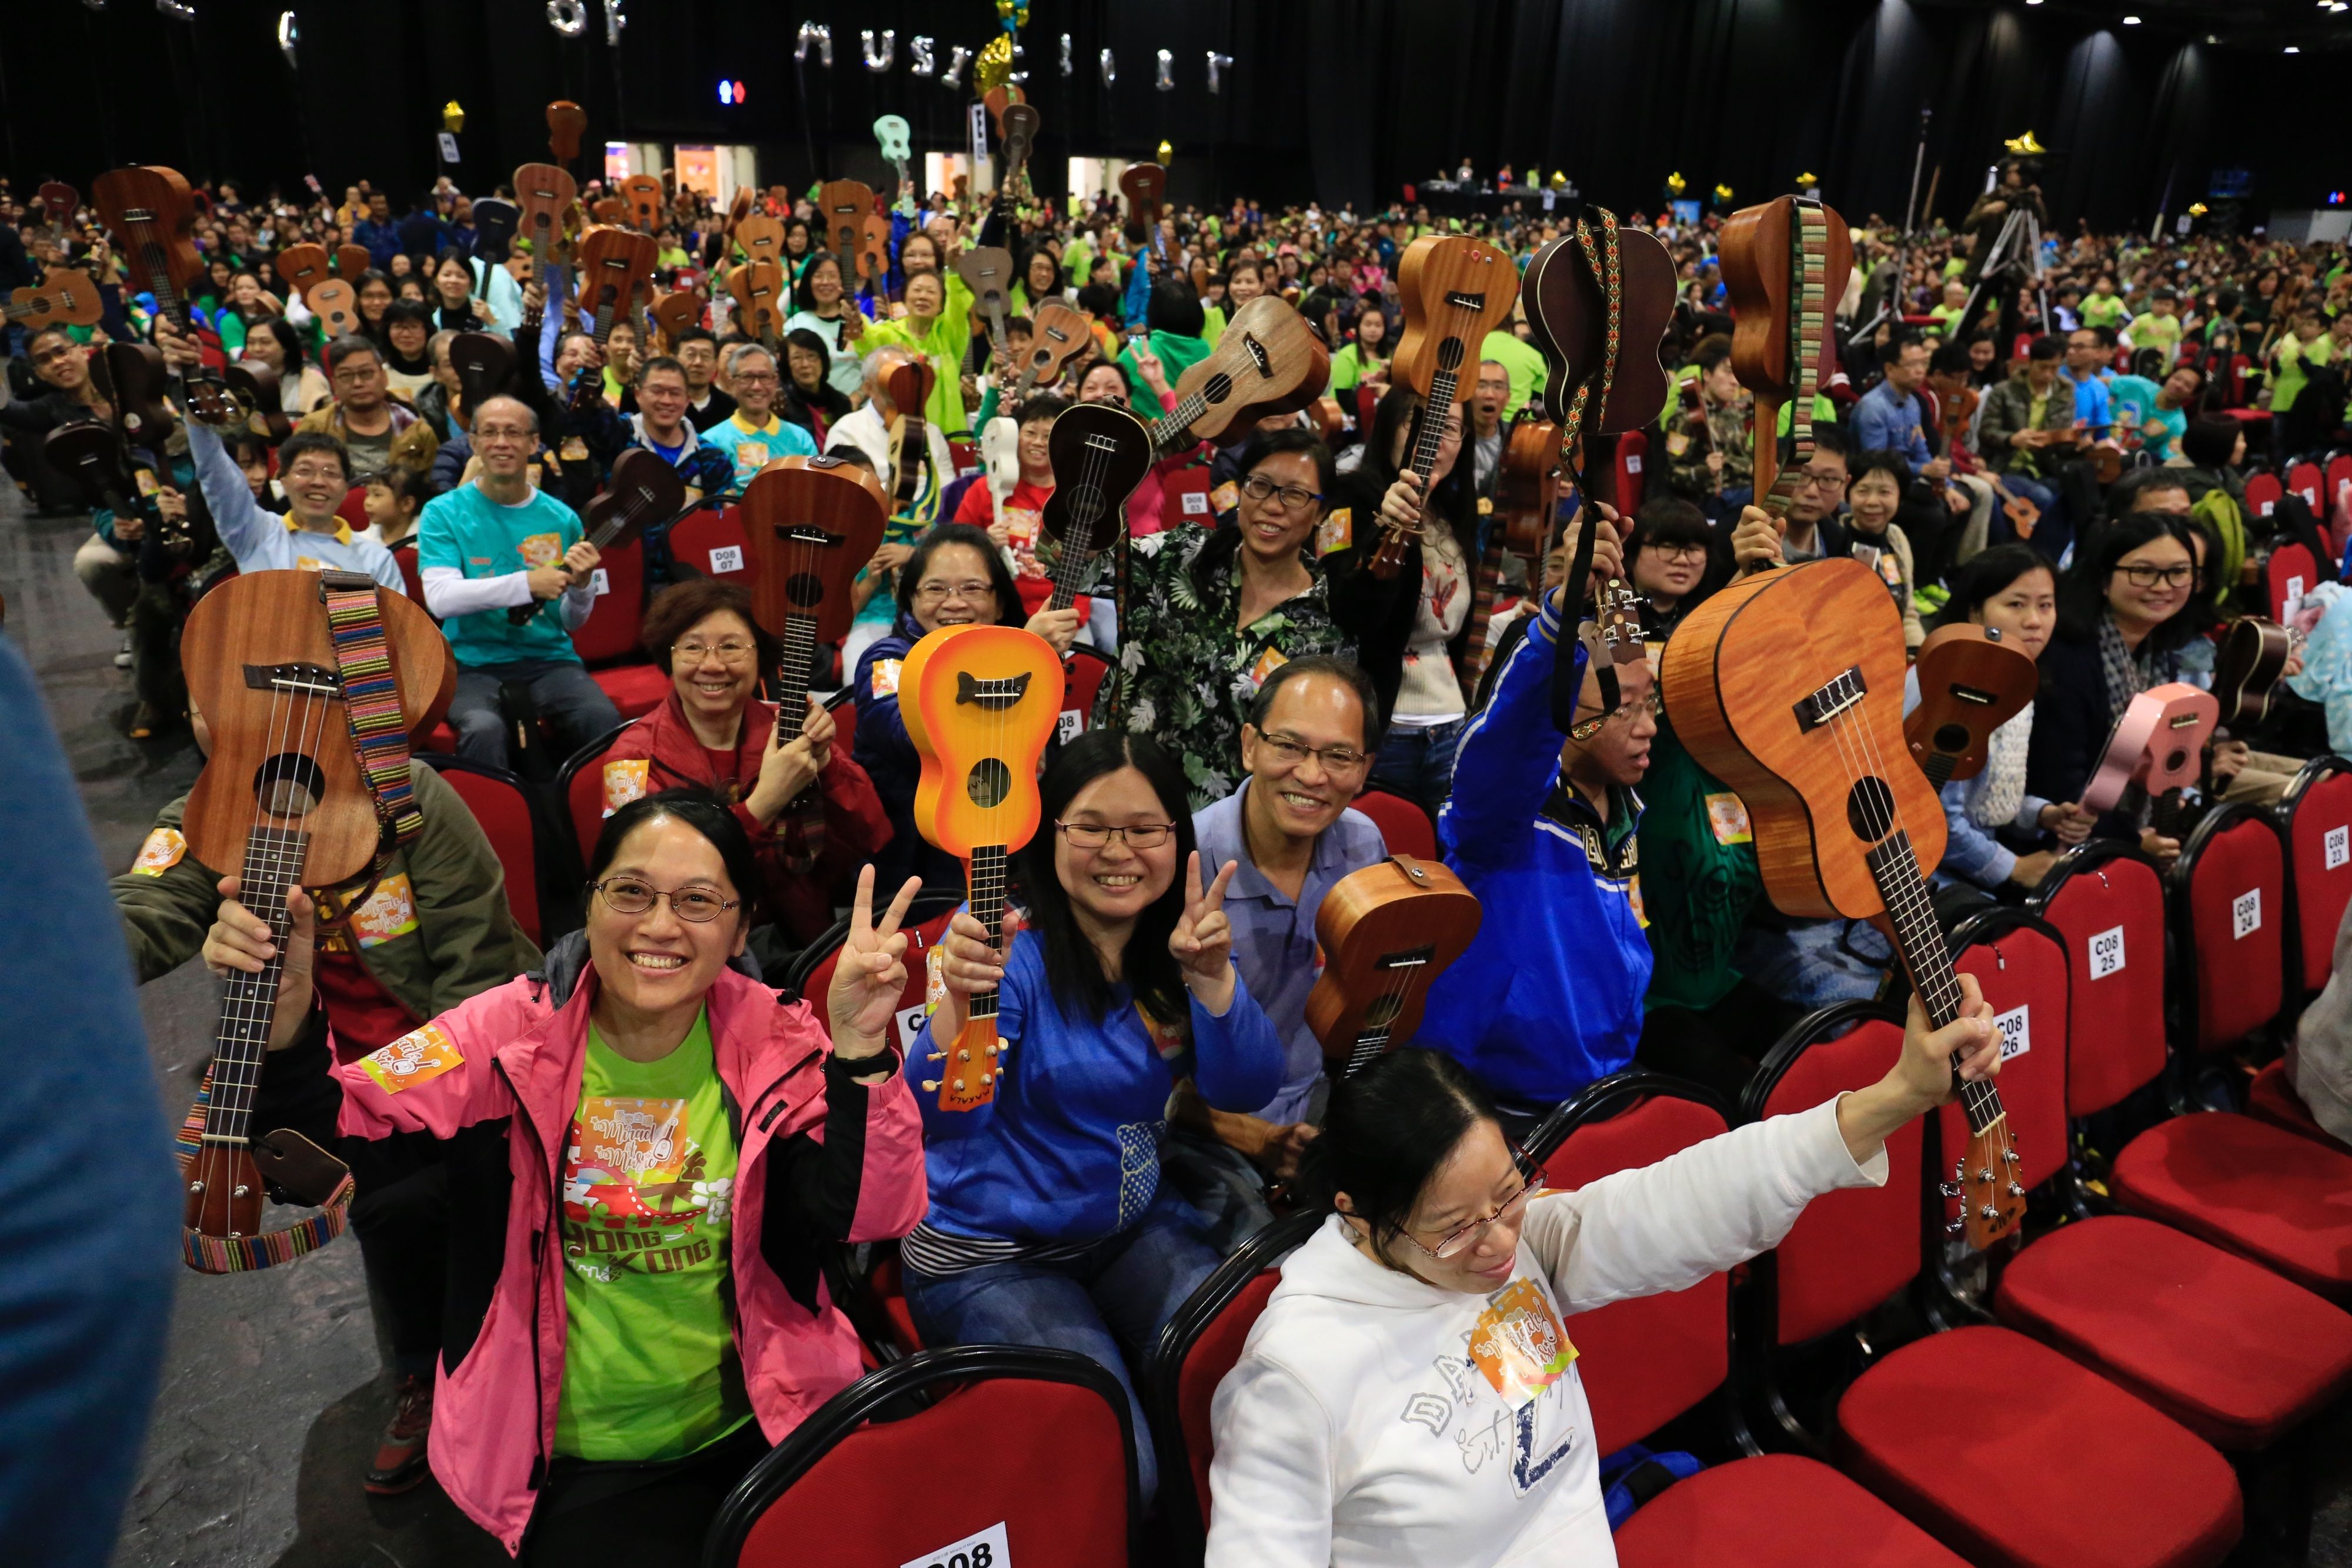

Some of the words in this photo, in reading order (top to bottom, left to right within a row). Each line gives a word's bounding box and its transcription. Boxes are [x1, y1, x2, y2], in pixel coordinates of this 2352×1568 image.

[716, 550, 736, 560] D08
[720, 560, 733, 570] 07
[1059, 716, 1074, 728] 08
[1062, 730, 1070, 743] 7
[2237, 897, 2256, 917] C08
[2242, 915, 2253, 932] 24
[2096, 935, 2118, 955] C08
[2101, 954, 2116, 973] 25
[2002, 1037, 2019, 1057] 26
[950, 1088, 990, 1102] MAKALA
[593, 1119, 659, 1145] Miracl
[926, 1543, 993, 1568] 08
